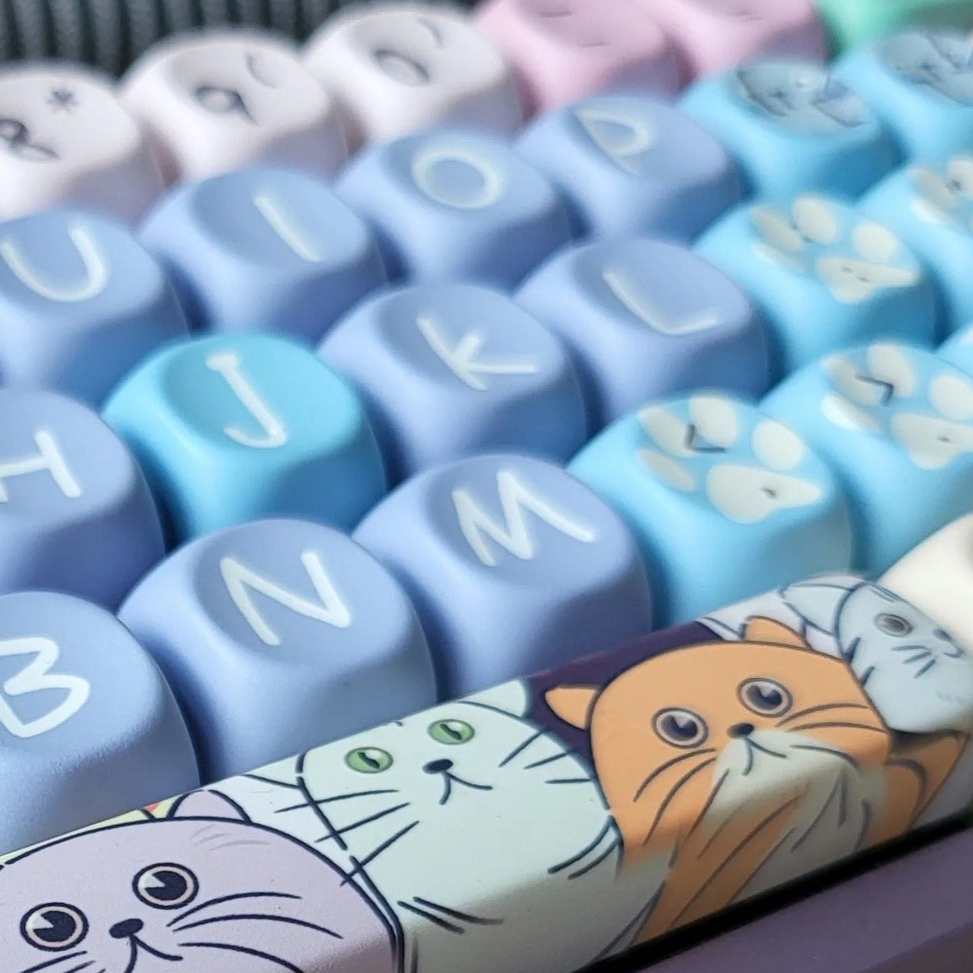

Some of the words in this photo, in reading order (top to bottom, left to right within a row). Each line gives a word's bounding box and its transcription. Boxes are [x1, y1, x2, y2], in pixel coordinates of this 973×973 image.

[195, 85, 257, 125] 9
[575, 107, 650, 175] P
[411, 148, 499, 210] O
[604, 271, 719, 335] L
[207, 352, 287, 449] J
[452, 470, 596, 566] M
[219, 552, 352, 645] N
